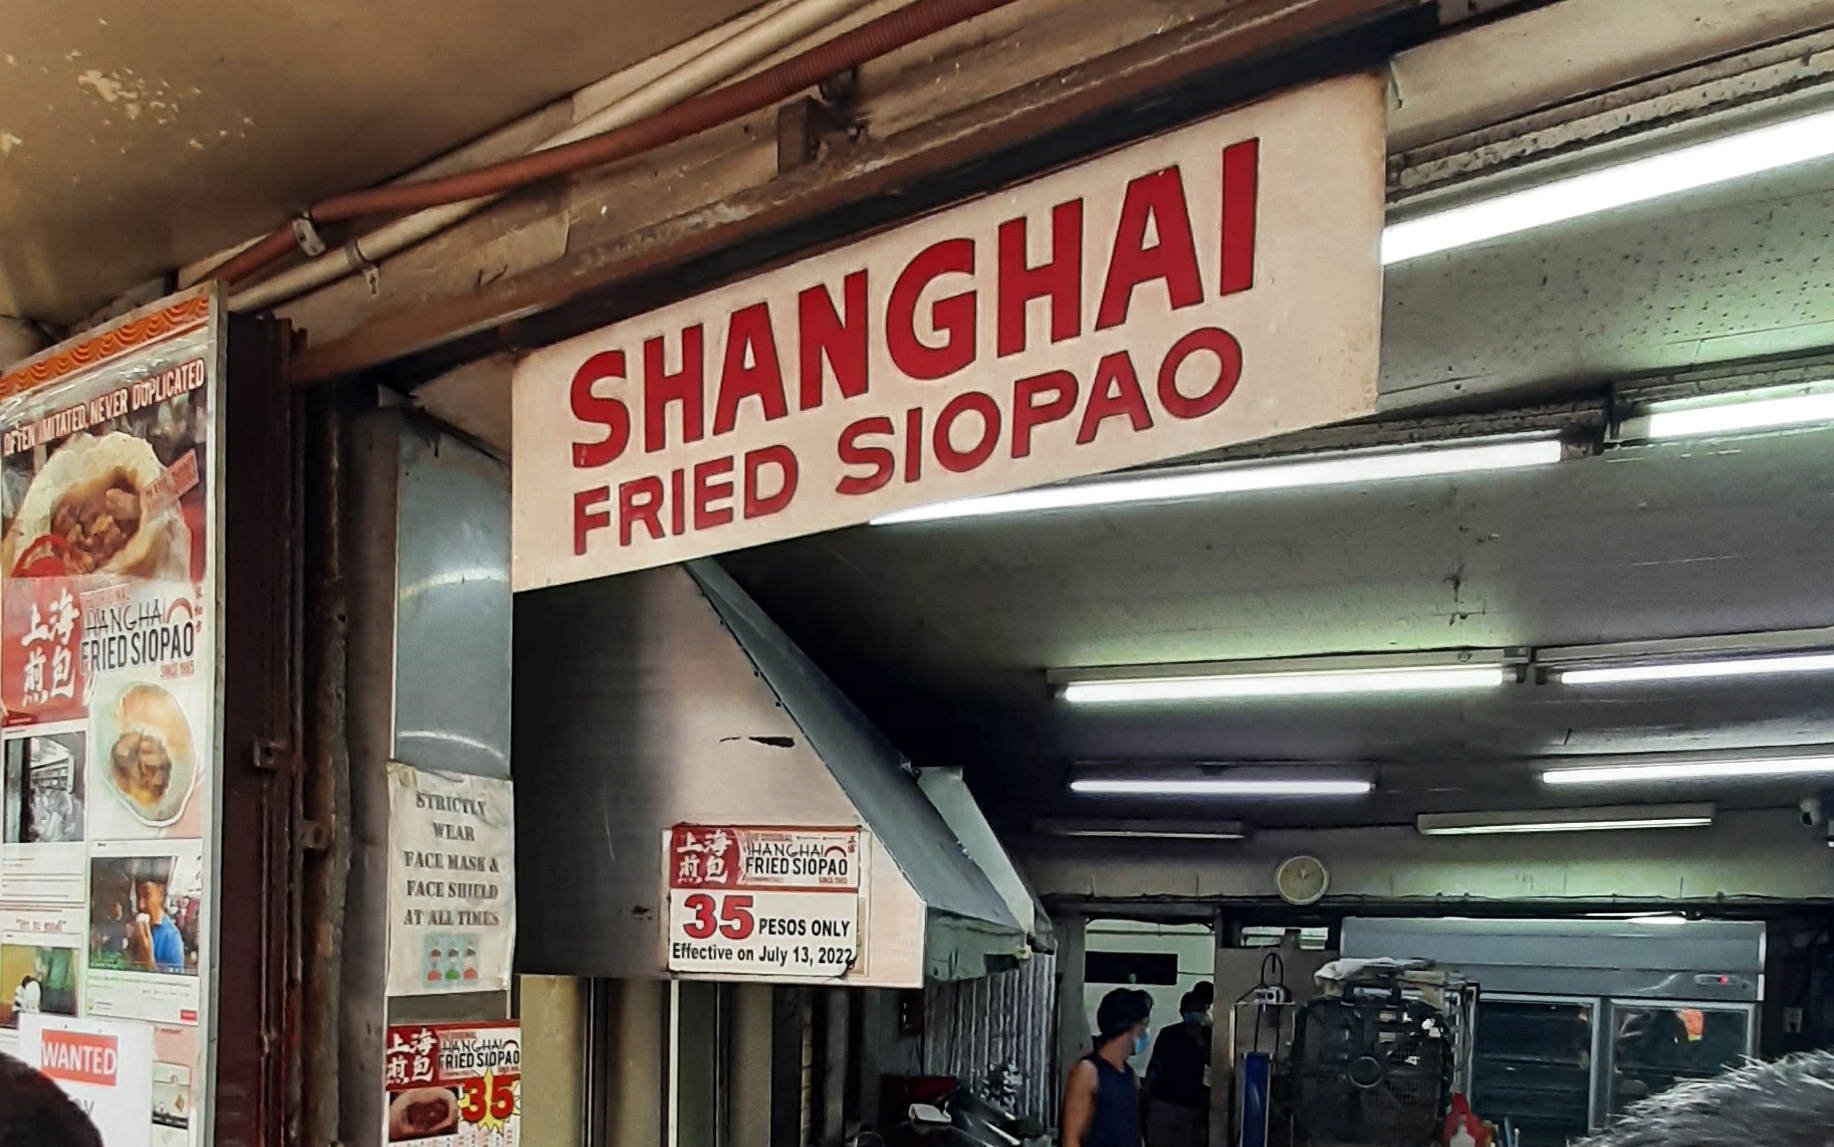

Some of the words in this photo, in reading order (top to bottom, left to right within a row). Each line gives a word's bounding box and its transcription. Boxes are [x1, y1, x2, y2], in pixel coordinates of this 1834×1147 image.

[571, 137, 1259, 469] SHANGHAI
[89, 386, 129, 427] NEVER
[573, 444, 798, 556] FRIED
[836, 326, 1243, 496] SIOPAO
[21, 586, 80, 647] 上海
[81, 634, 127, 673] FRIED
[130, 621, 194, 666] SIOPAO
[416, 790, 486, 817] STRICTLY
[433, 821, 476, 842] WEAR
[676, 828, 733, 857] 上海
[403, 850, 444, 872] FACE
[447, 855, 486, 873] MASK
[489, 857, 499, 873] &
[745, 857, 789, 875] FRIED
[792, 858, 848, 876] SIOPAO
[406, 879, 444, 898] FACE
[447, 881, 499, 901] SHIELD
[403, 908, 424, 926] AT
[427, 909, 454, 926] ALL
[457, 910, 500, 926] TIMES
[683, 893, 754, 940] 35
[759, 918, 806, 936] PESOS
[811, 919, 850, 937] ONLY
[672, 942, 733, 960] Effective
[737, 949, 754, 961] on
[759, 945, 788, 966] July
[793, 946, 814, 966] 13,
[818, 946, 853, 964] 2022
[387, 1028, 437, 1056] 上海
[42, 1041, 117, 1075] WANTED
[437, 1052, 474, 1069] FRIED
[476, 1050, 520, 1067] SIOPAO
[461, 1075, 514, 1123] 35
